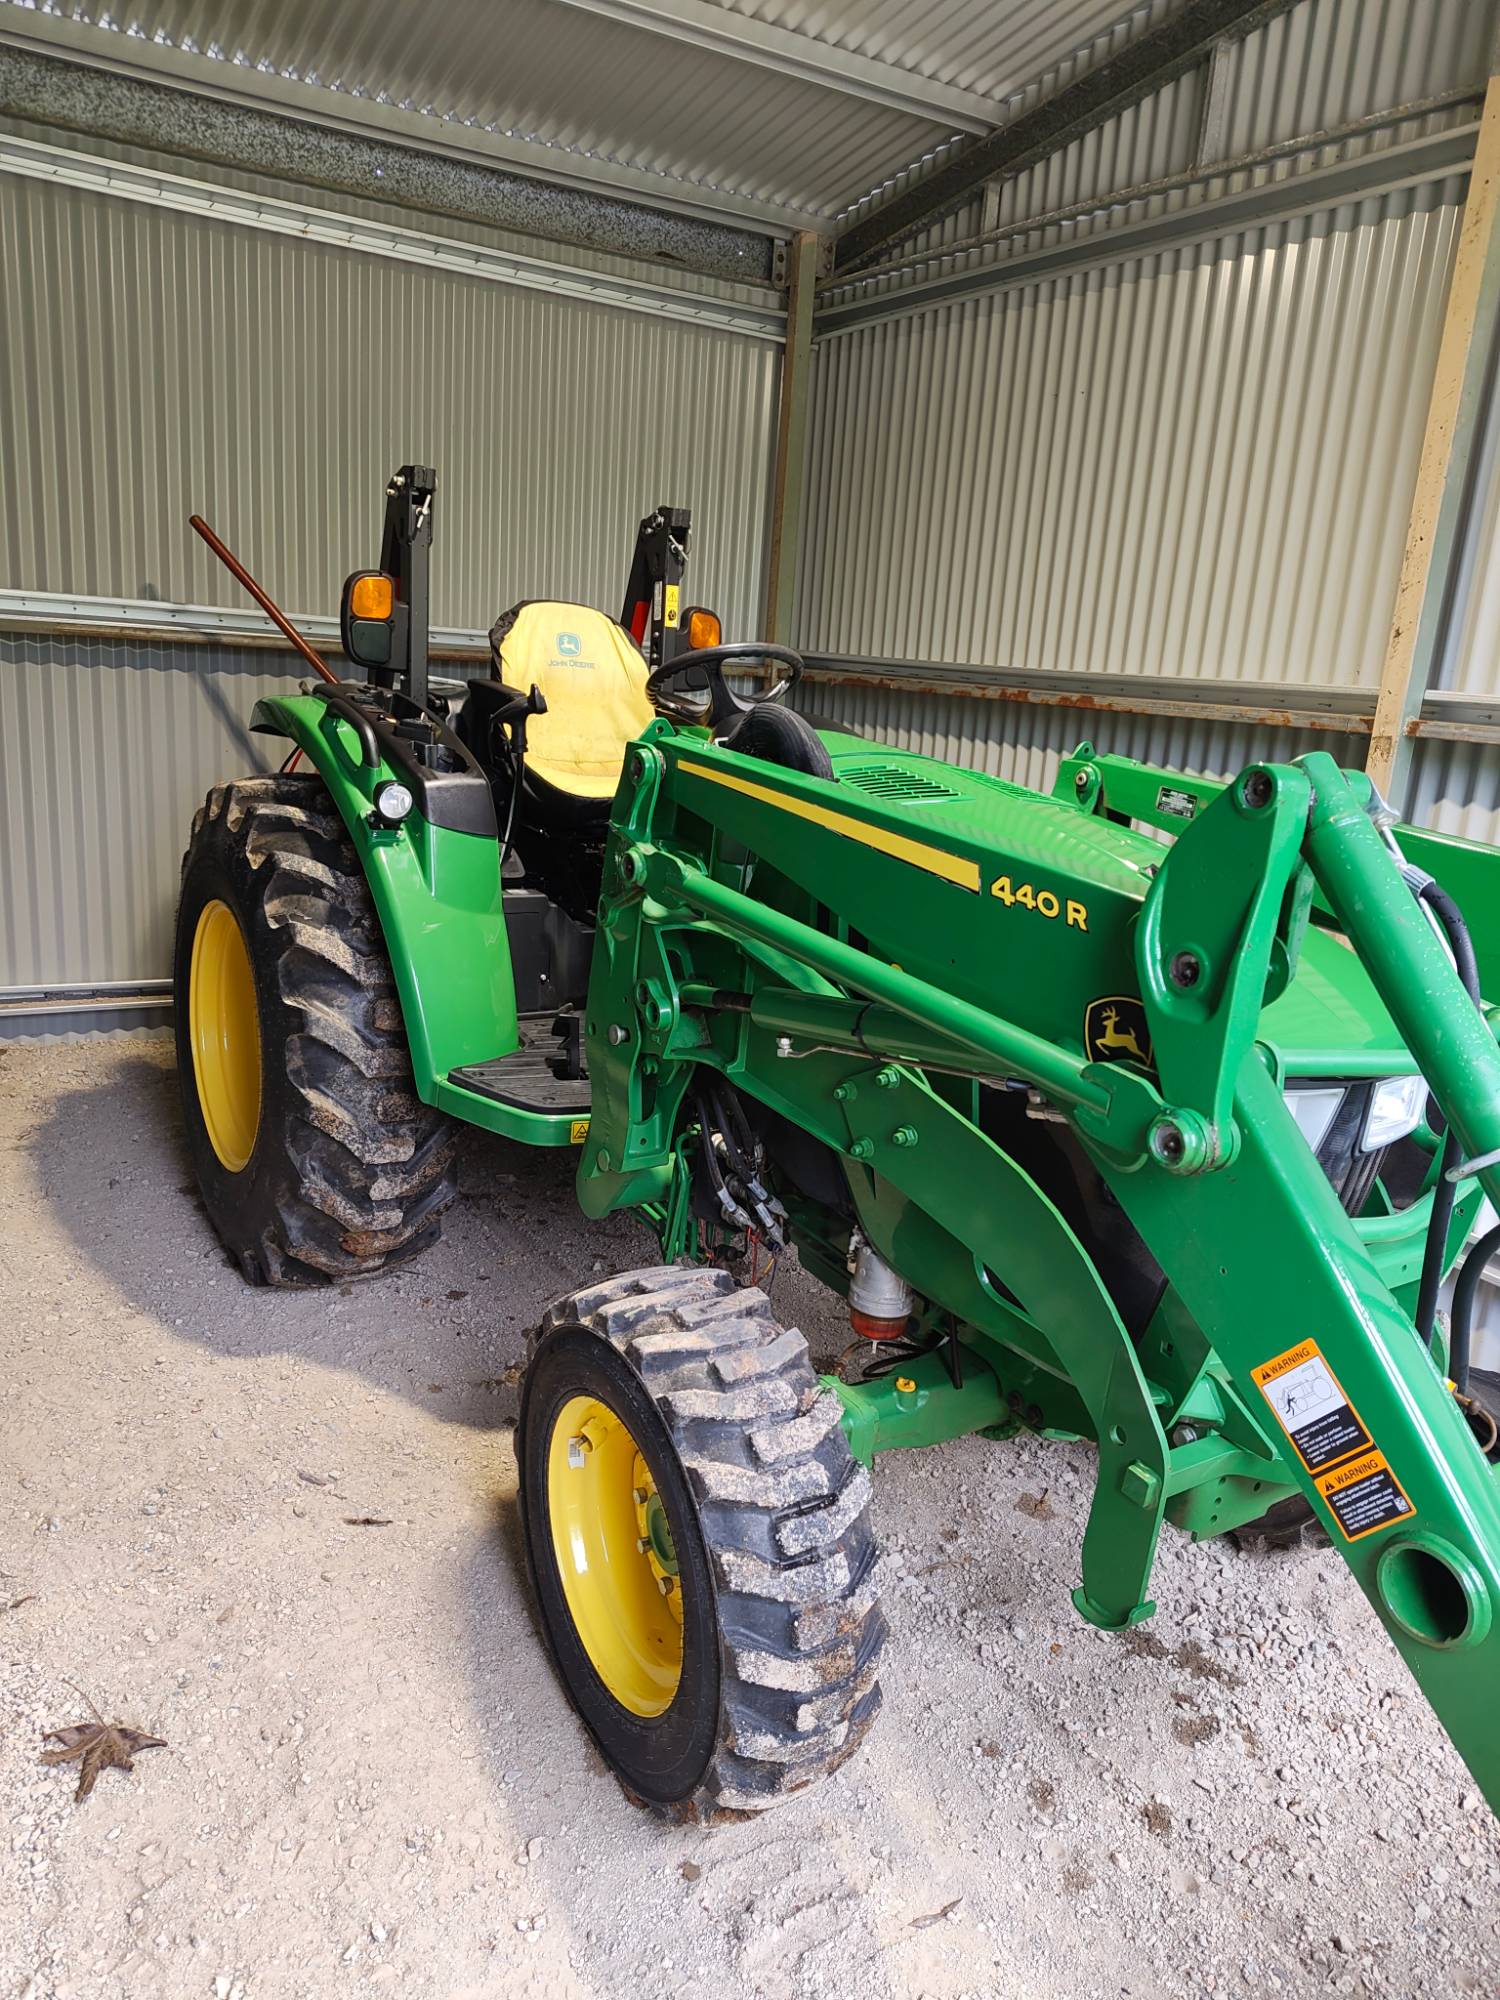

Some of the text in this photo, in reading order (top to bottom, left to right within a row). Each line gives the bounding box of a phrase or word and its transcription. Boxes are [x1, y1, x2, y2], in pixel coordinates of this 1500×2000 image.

[548, 659, 568, 668] JOHN
[990, 875, 1088, 932] 440 R
[1269, 1347, 1310, 1374] WARNING
[1334, 1459, 1379, 1485] WARNING
